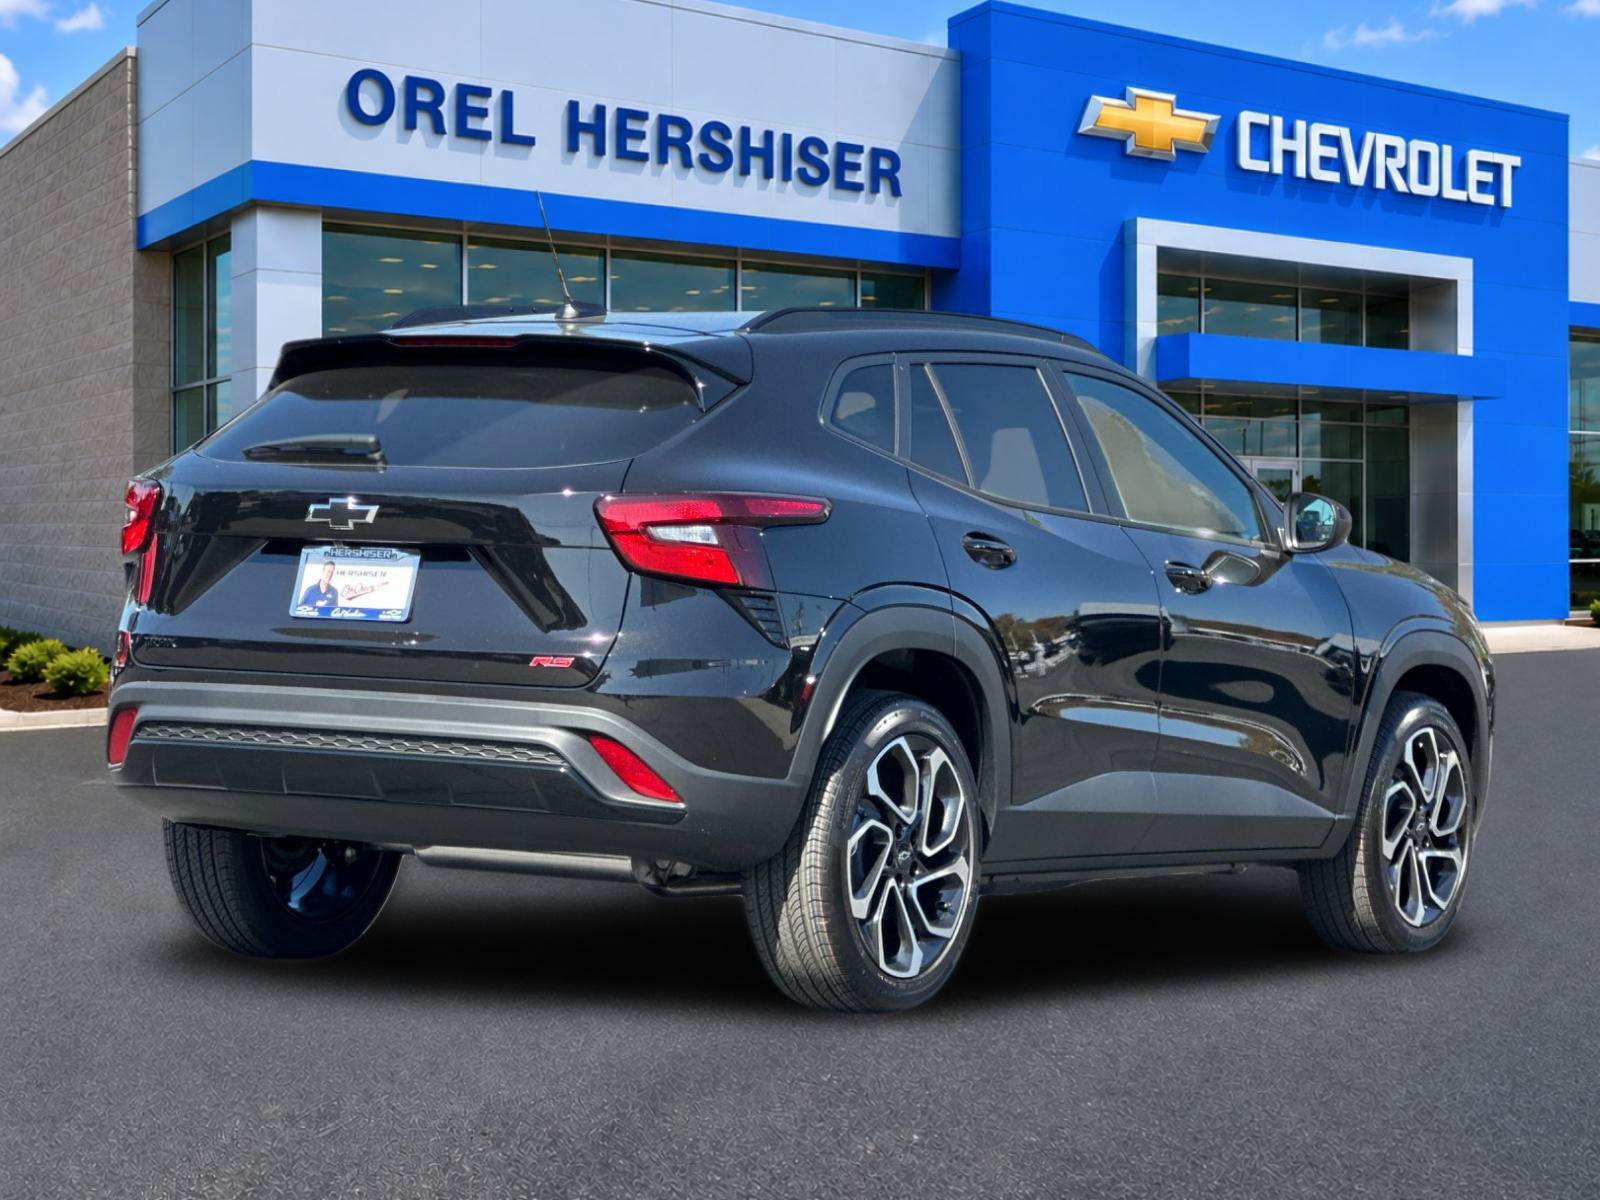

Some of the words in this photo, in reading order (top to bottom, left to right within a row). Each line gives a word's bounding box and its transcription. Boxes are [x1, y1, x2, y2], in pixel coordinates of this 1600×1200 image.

[346, 68, 536, 147] OREL
[567, 99, 902, 197] HERSHISER
[1237, 110, 1522, 208] CHEVROLET
[330, 548, 392, 559] HERSHISER
[529, 656, 575, 668] RS
